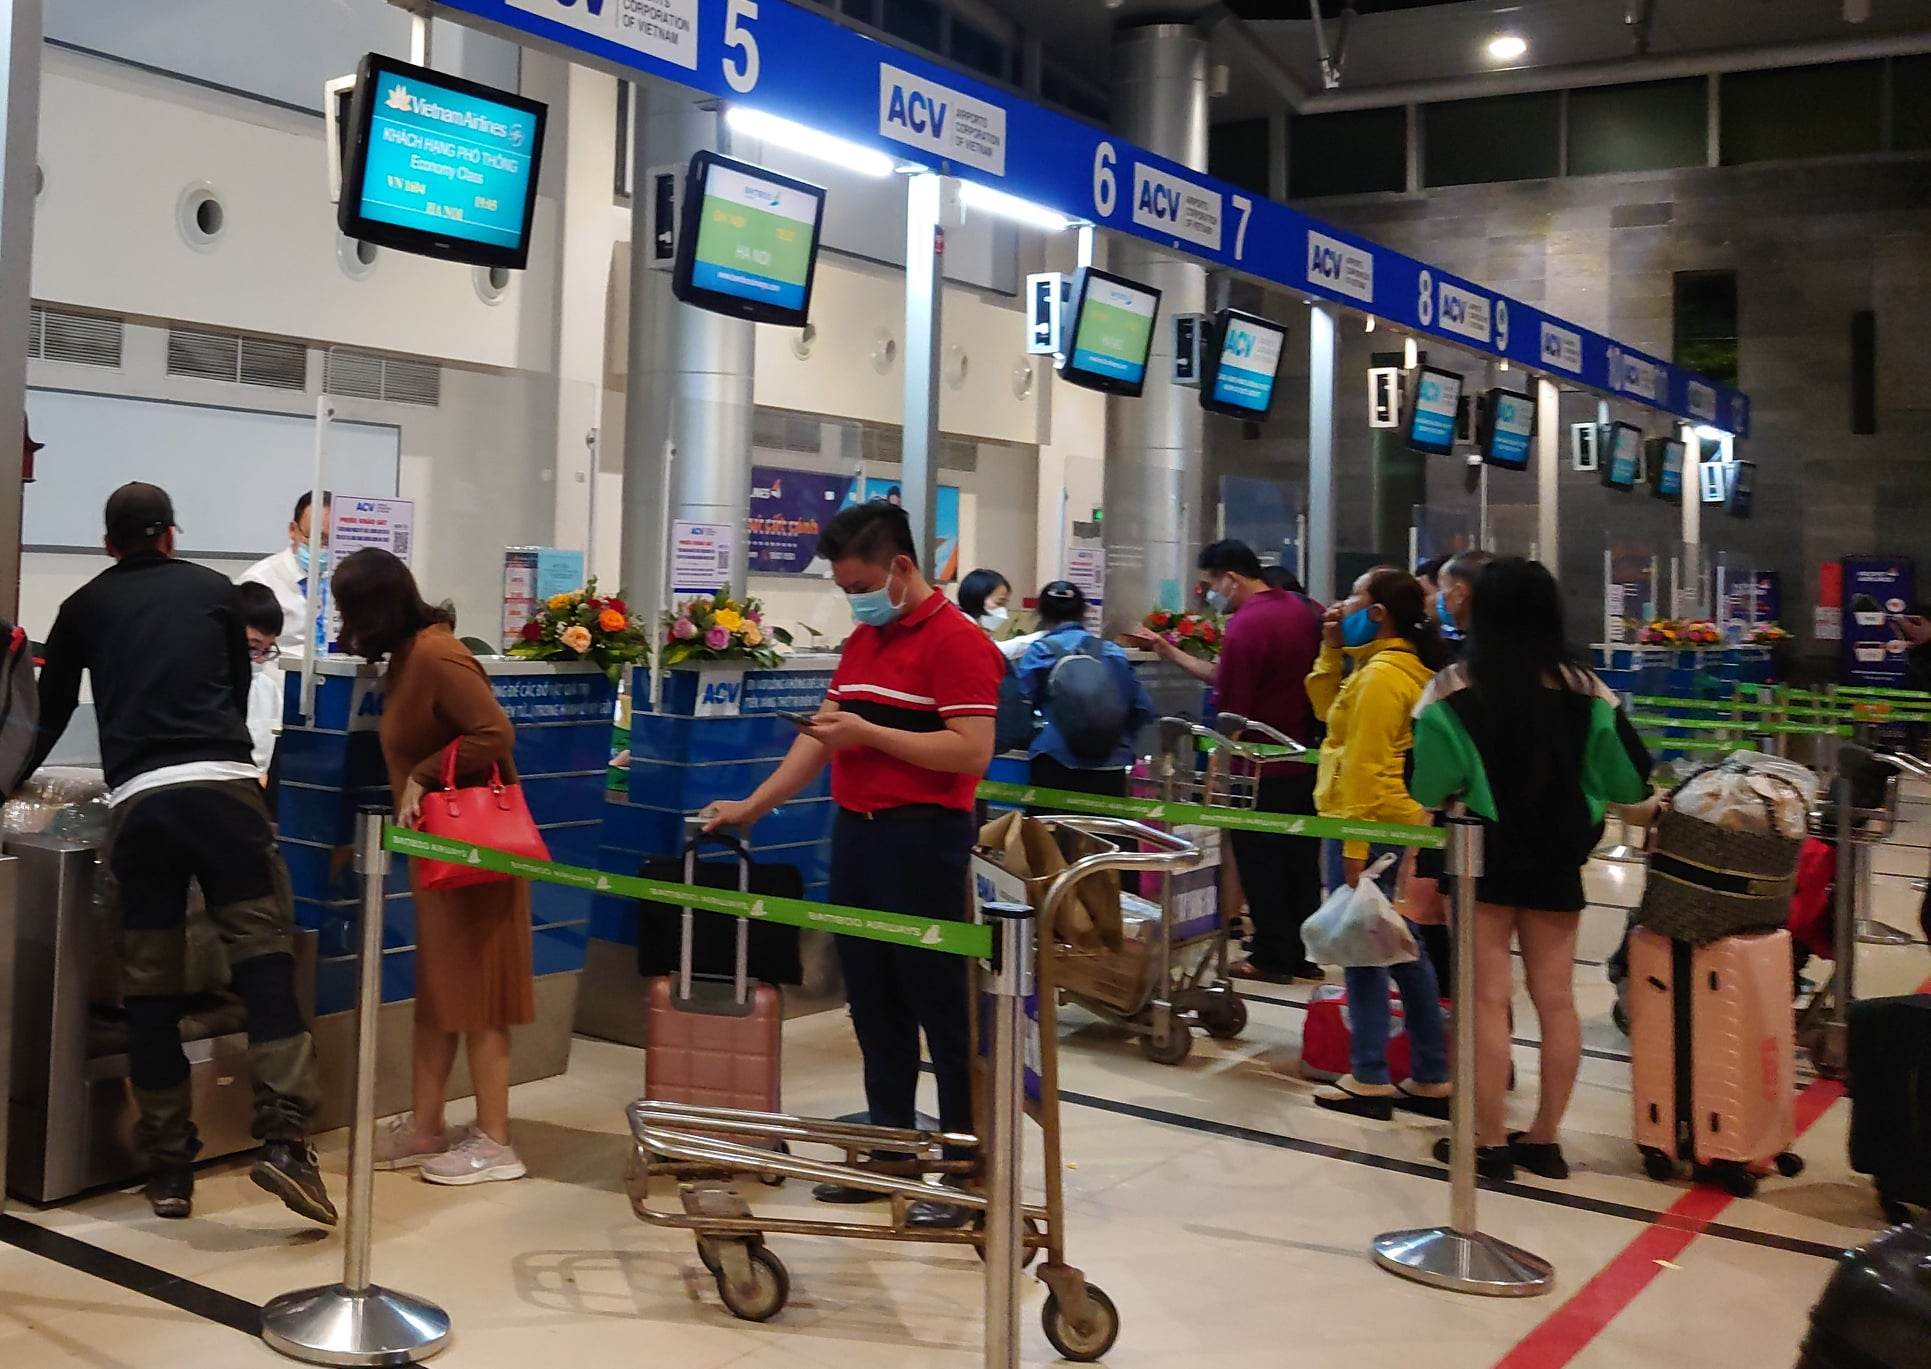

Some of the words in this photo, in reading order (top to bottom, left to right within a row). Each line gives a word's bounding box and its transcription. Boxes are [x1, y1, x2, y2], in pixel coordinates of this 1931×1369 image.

[622, 14, 635, 28] OF
[638, 17, 680, 45] VIETNAM
[623, 0, 690, 32] CORPORATION
[722, 0, 760, 93] 5
[410, 95, 464, 126] Vietnam
[462, 111, 508, 138] Airlines
[887, 84, 946, 139] ACV
[1093, 141, 1117, 217] 6
[1139, 179, 1181, 222] ACV
[1232, 194, 1252, 260] 7
[1311, 245, 1342, 280] ACV
[1418, 270, 1433, 326] 8
[1442, 293, 1467, 324] ACV
[1223, 329, 1256, 358] ACV
[1496, 300, 1508, 351] 9
[356, 502, 375, 512] ACV
[702, 682, 740, 705] ACV
